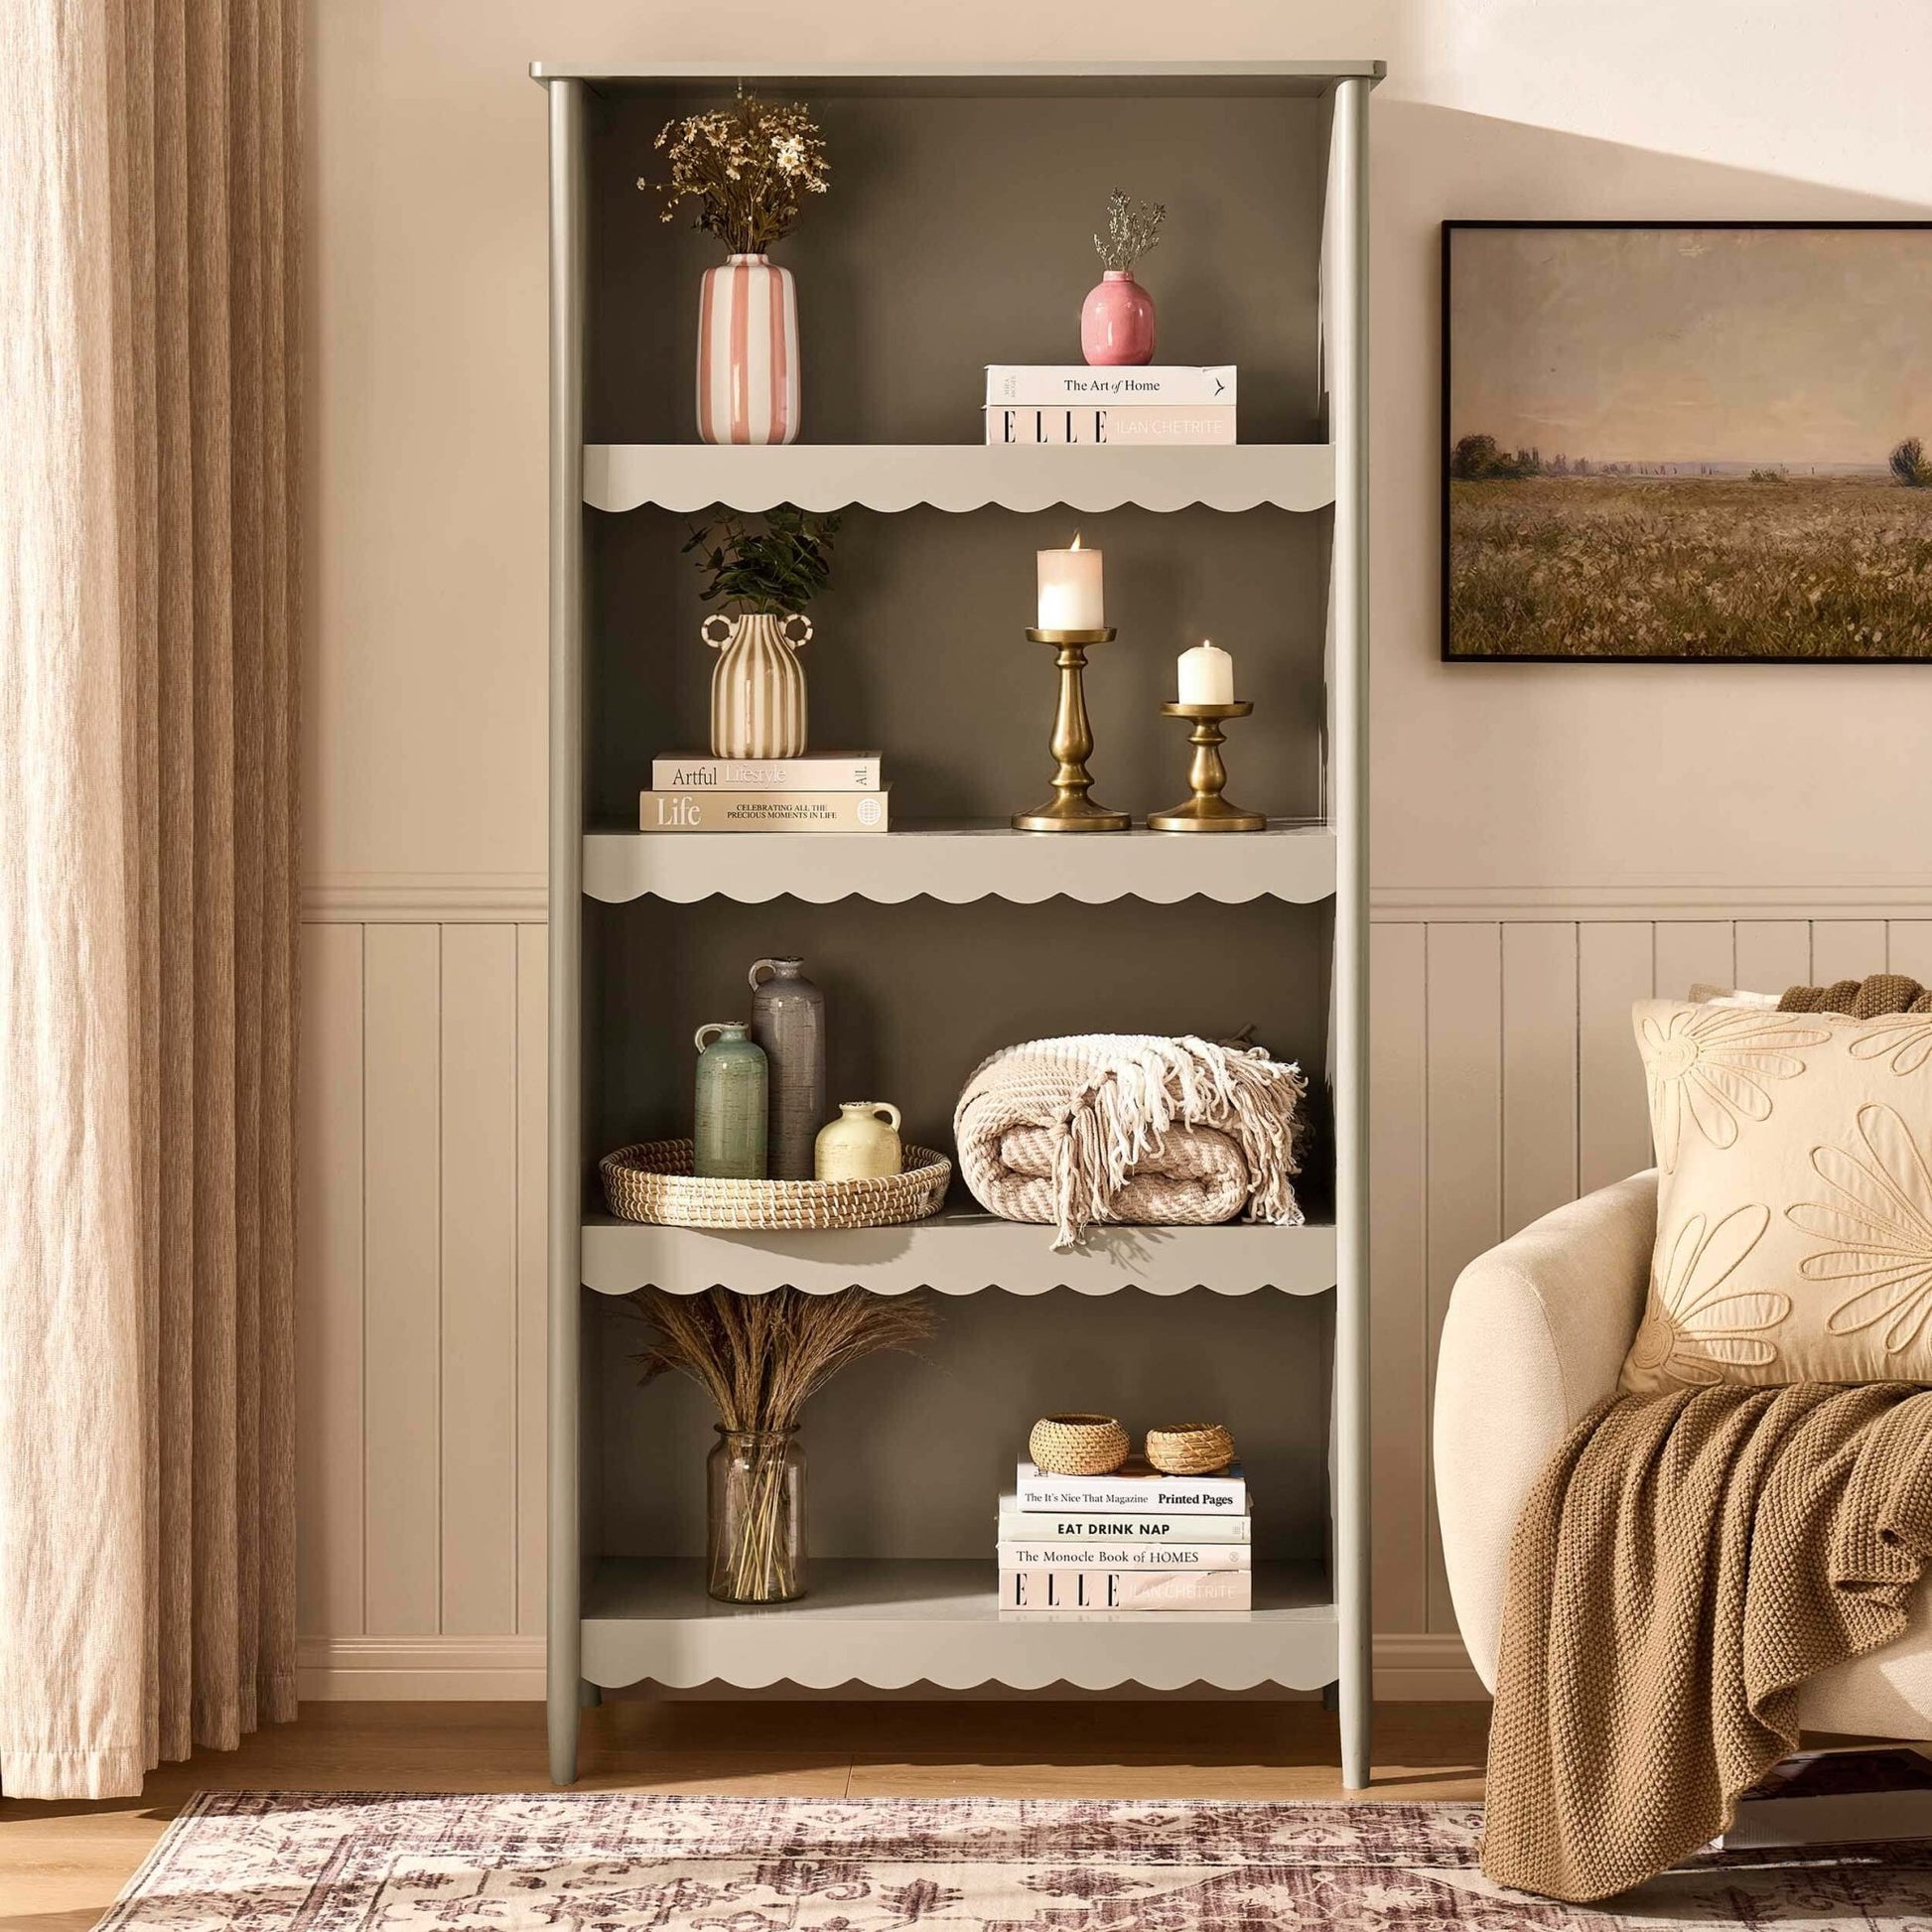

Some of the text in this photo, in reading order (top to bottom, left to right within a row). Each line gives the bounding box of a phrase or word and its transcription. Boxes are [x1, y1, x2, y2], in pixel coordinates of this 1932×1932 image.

[1064, 379, 1161, 394] The Art of Home
[1004, 410, 1107, 444] ELLE
[1117, 420, 1223, 434] ILAN CHETRITE
[672, 763, 786, 789] Artful Lifestyle
[657, 796, 701, 826] Life
[1025, 1492, 1149, 1505] The It's Nice That Magazine
[1158, 1493, 1233, 1507] Printed Pages
[1057, 1523, 1171, 1535] EAT DRINK NAP
[1016, 1550, 1199, 1564] The Monocle Book of HOMES
[1016, 1573, 1120, 1607] ELLE
